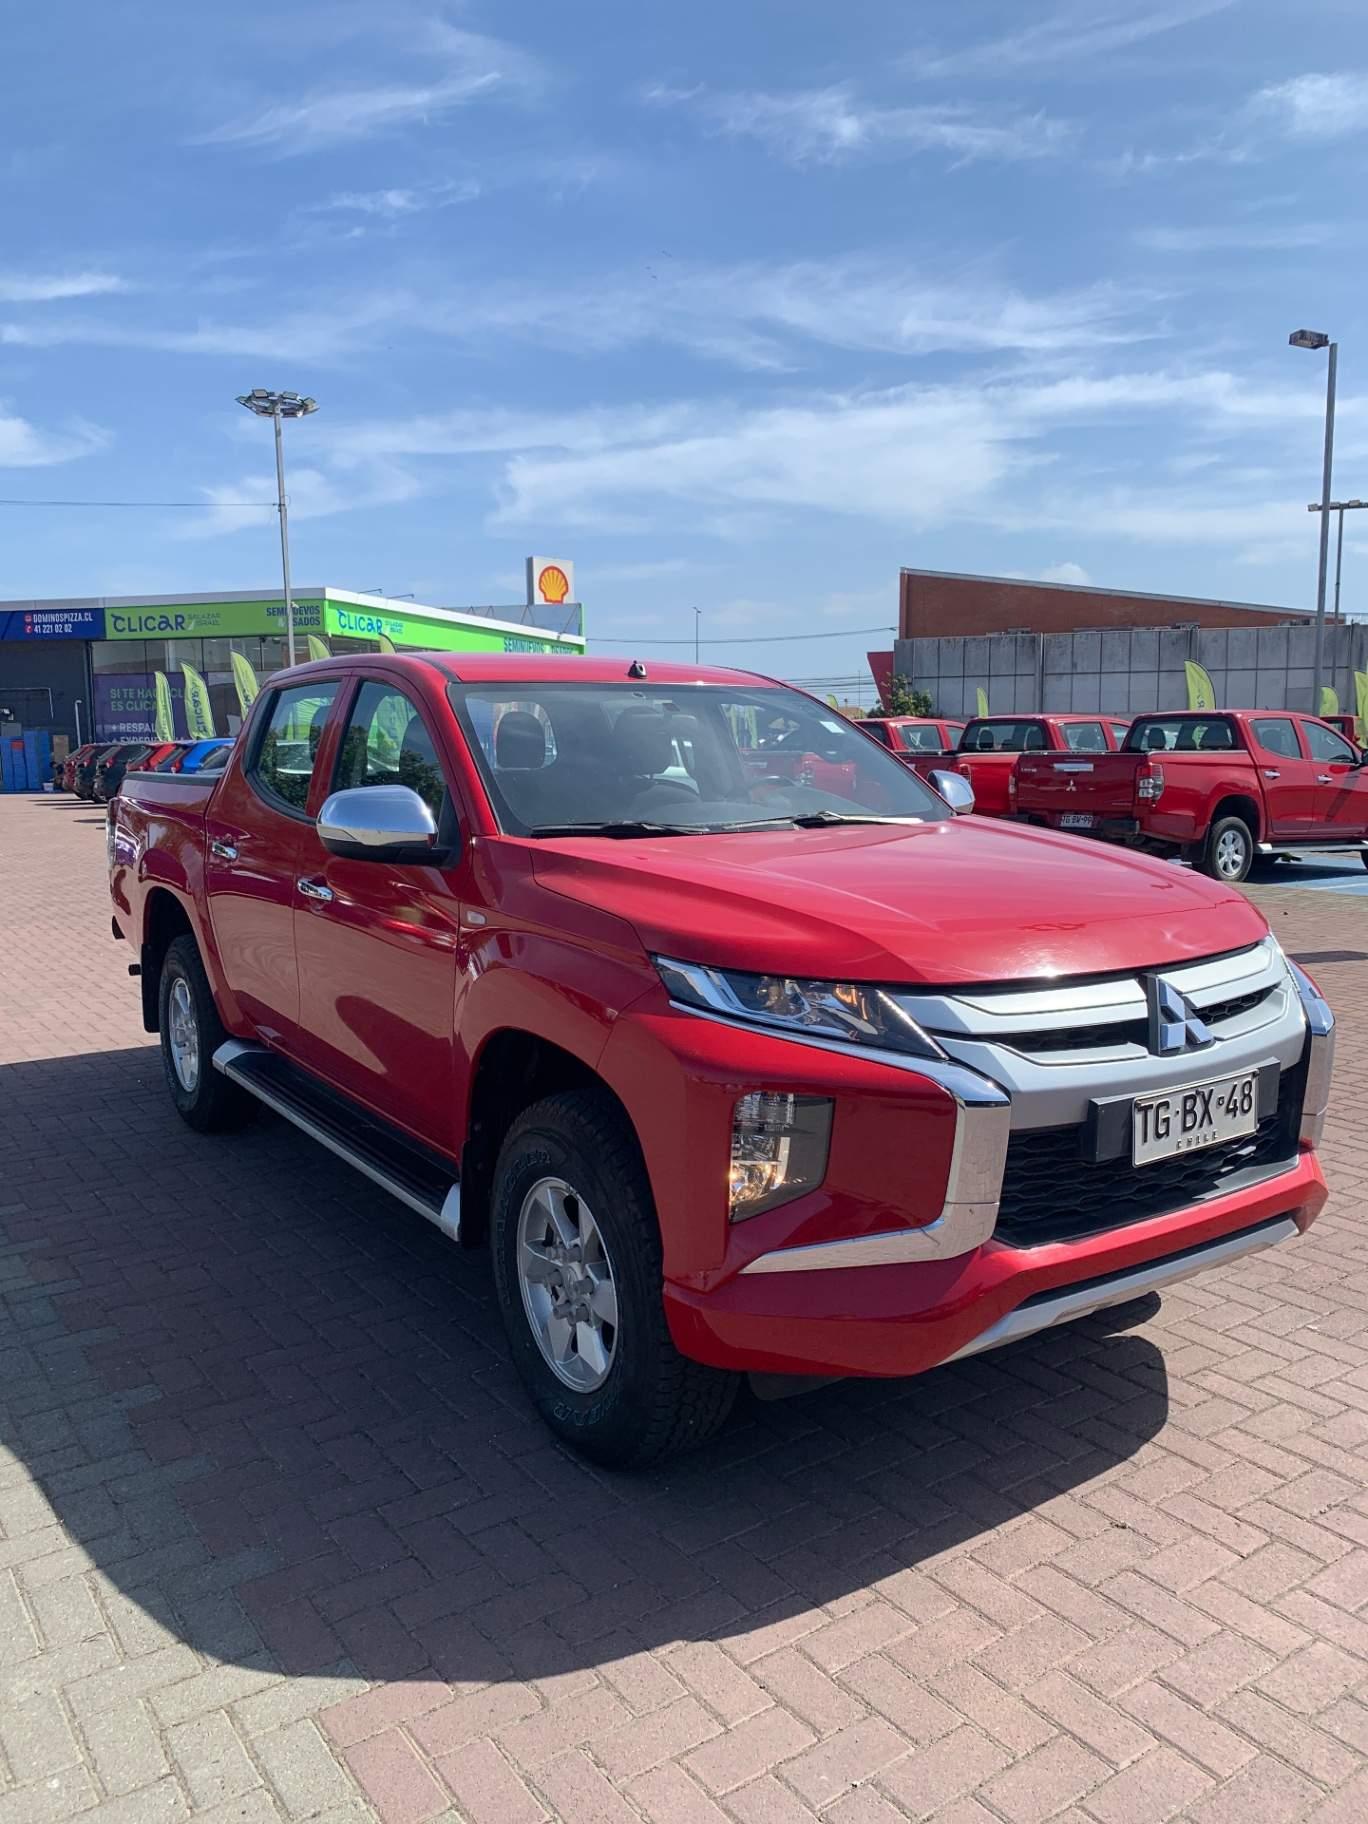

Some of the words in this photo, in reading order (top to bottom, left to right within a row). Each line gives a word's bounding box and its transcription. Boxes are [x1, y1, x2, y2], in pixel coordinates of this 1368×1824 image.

[266, 605, 320, 617] SEMIUEVOS
[33, 612, 93, 623] DOMINOSPIZZA.CL
[292, 616, 320, 627] SADOS
[34, 624, 41, 633] 41
[42, 624, 53, 633] 221
[54, 624, 63, 632] 02
[64, 623, 73, 632] 02
[122, 687, 135, 698] TE
[111, 700, 124, 711] ES
[119, 722, 156, 733] RESPAL
[1175, 1130, 1219, 1151] CHILE
